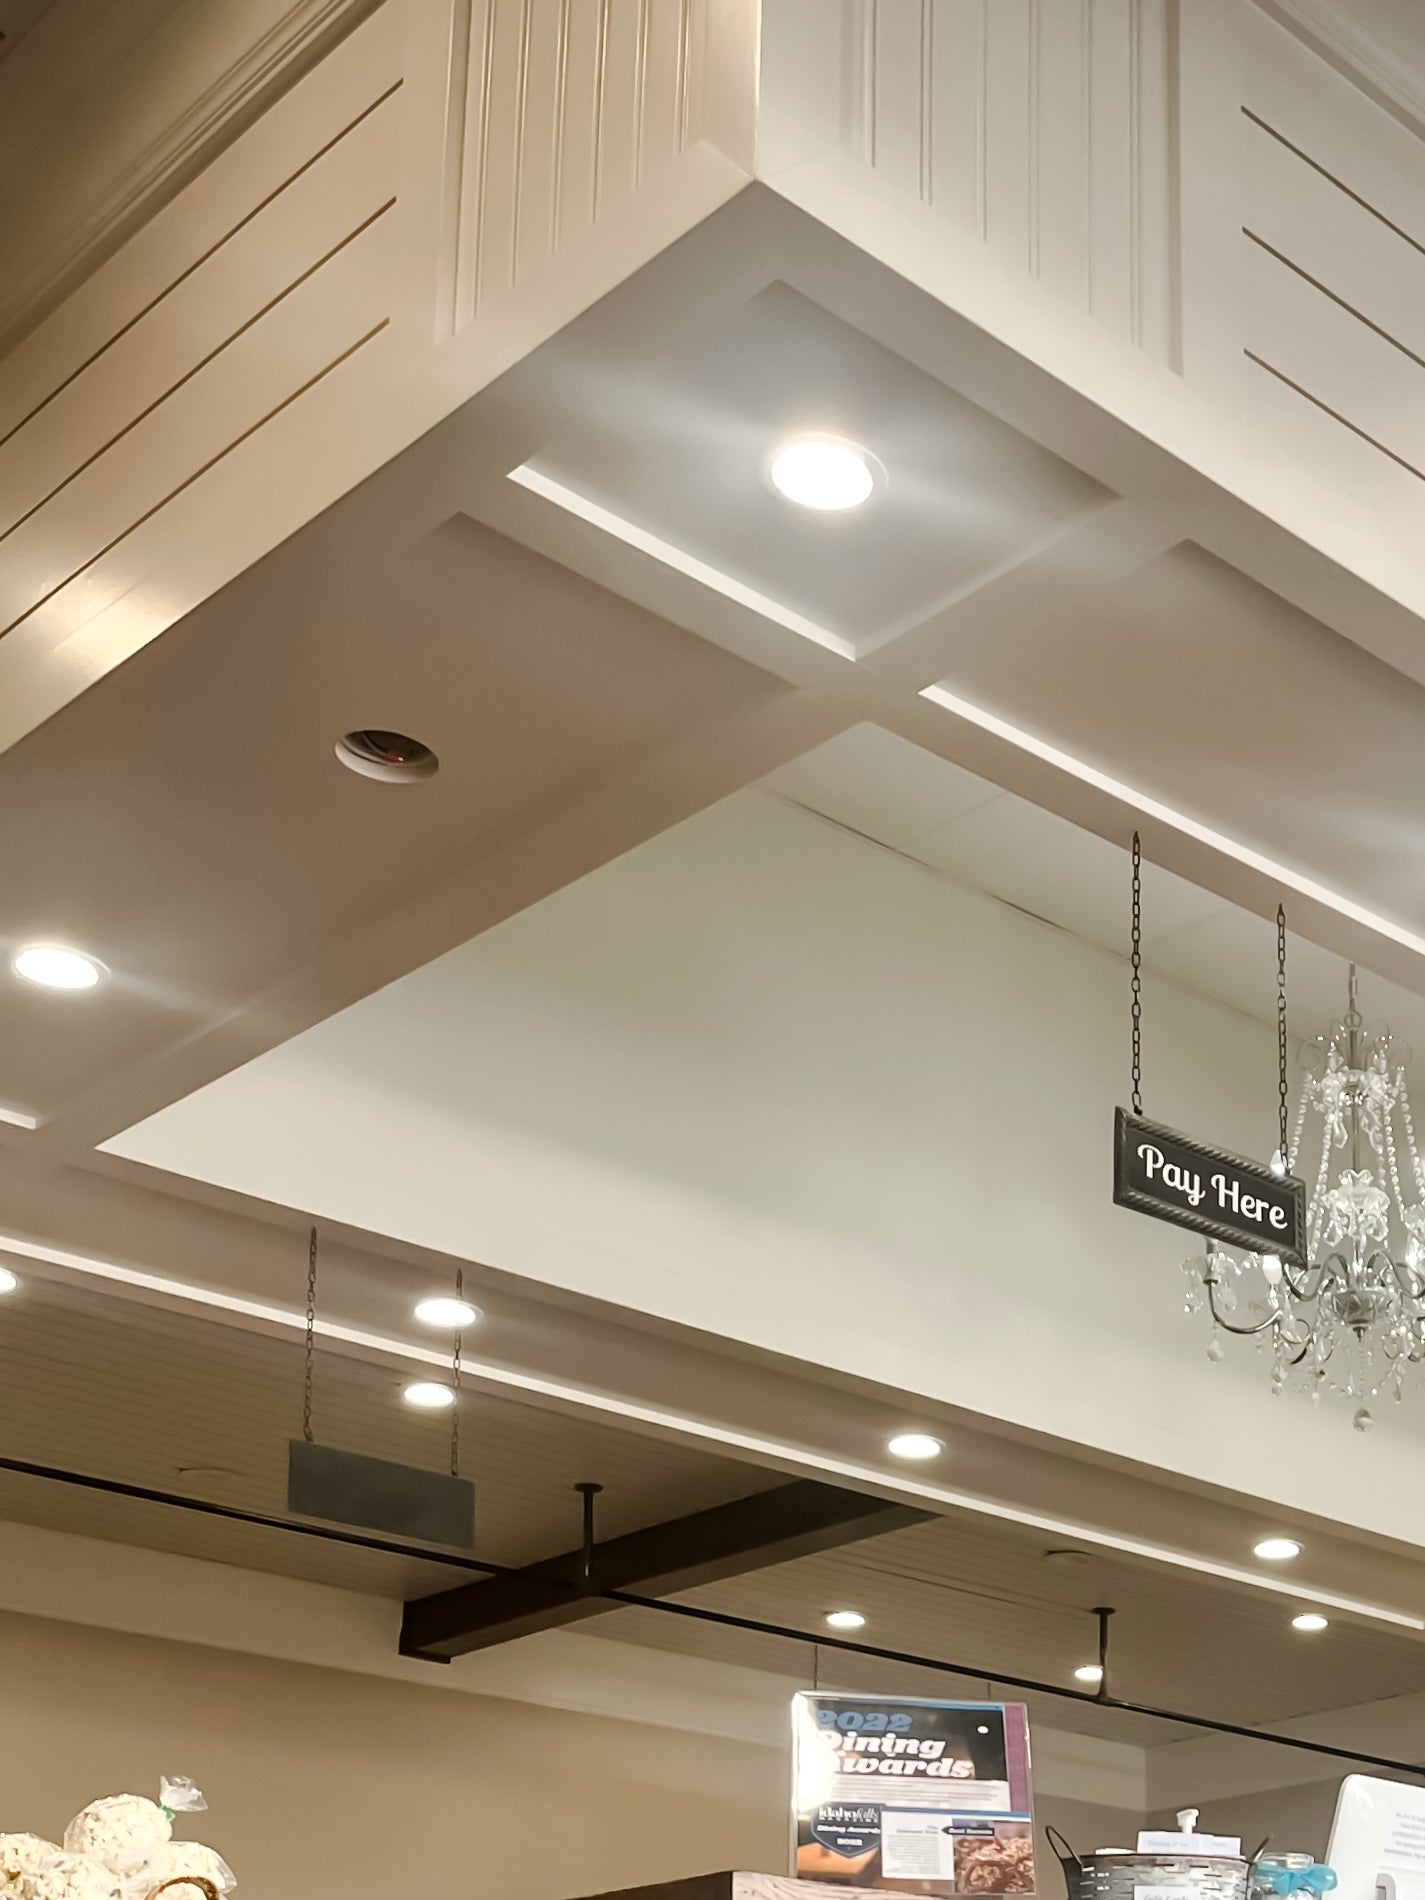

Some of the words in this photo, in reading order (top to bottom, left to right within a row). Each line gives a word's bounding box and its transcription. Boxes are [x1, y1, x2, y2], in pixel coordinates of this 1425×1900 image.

[1137, 1143, 1206, 1206] Pay
[1210, 1173, 1289, 1230] Here
[817, 1709, 913, 1733] 2022
[828, 1752, 975, 1779] wards
